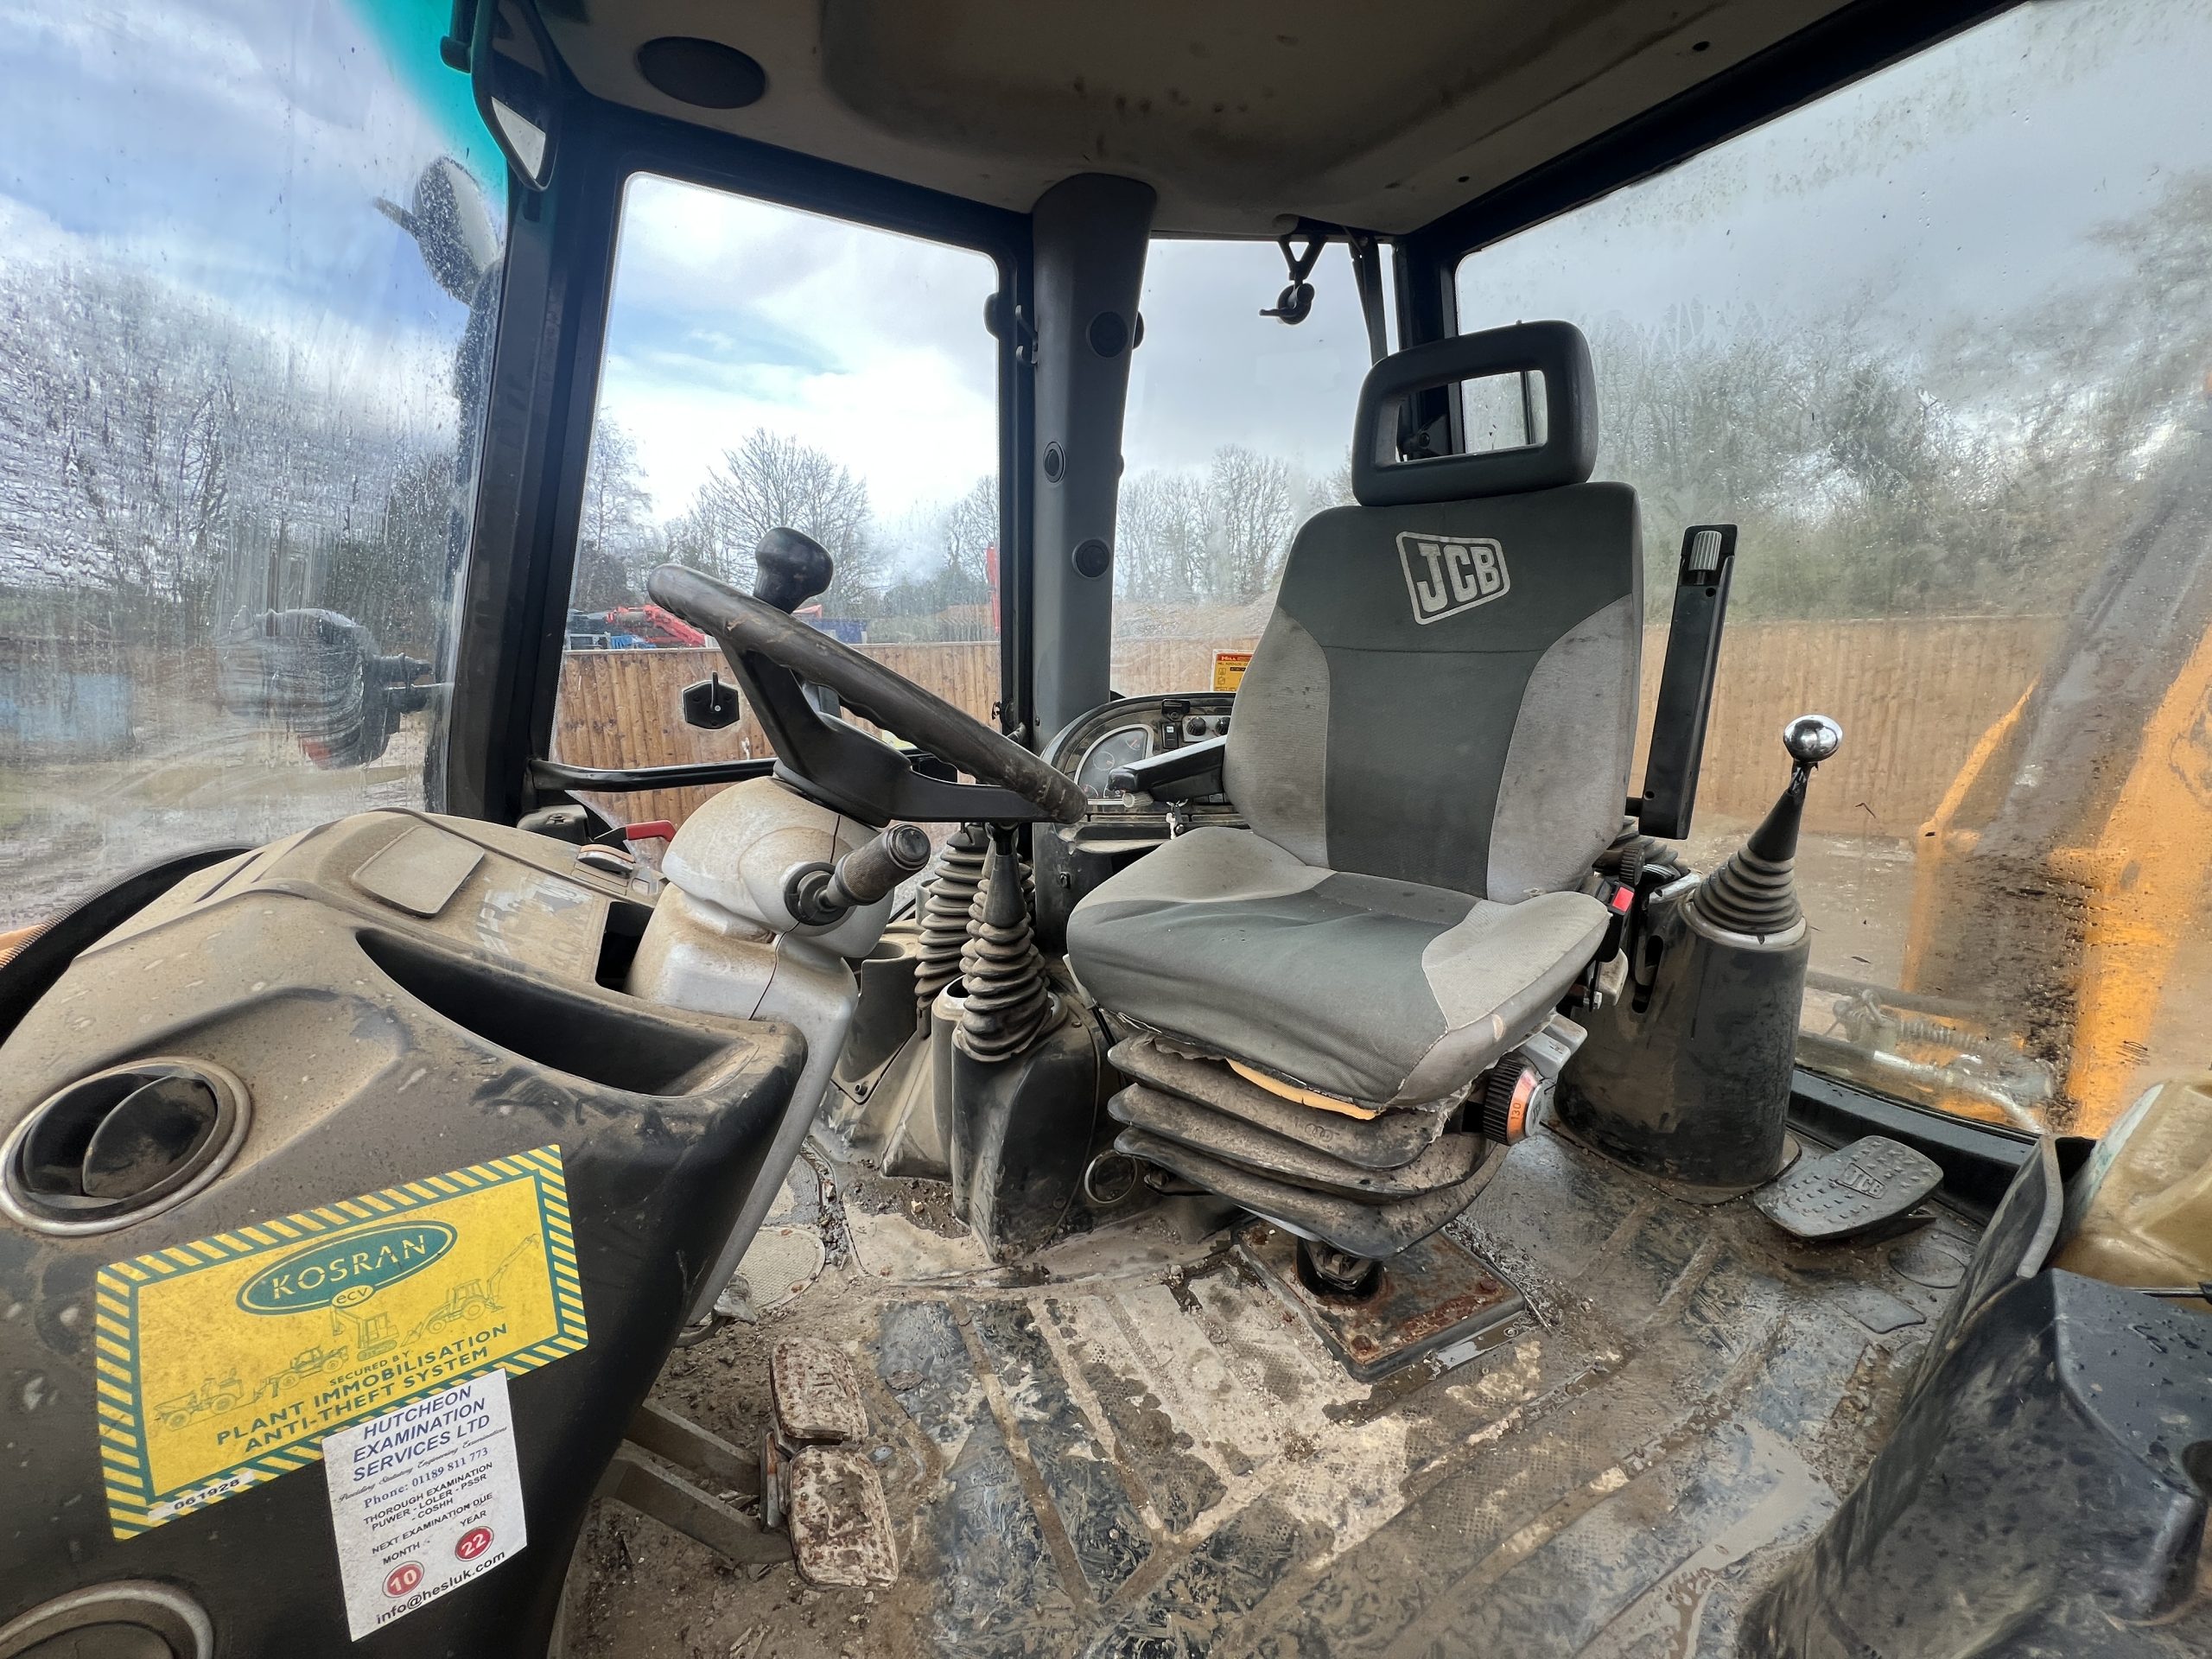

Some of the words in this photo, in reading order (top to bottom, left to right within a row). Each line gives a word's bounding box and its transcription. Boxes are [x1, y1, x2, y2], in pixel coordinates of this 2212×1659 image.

[1417, 543, 1500, 613] JCB
[1510, 1103, 1521, 1120] 130
[1842, 1166, 1885, 1195] JCB
[272, 1235, 426, 1300] KOSRAN
[336, 1287, 367, 1305] ecv
[217, 1402, 304, 1446] PLANT
[314, 1323, 507, 1408] IMMOBILISATION
[330, 1360, 387, 1386] SECURED
[392, 1351, 410, 1363] BY
[245, 1382, 395, 1452] ANTI-THEFT
[404, 1346, 487, 1389] SYSTEM
[364, 1385, 471, 1440] HUTCHEON
[353, 1397, 485, 1463] EXAMINATION
[353, 1431, 450, 1482] SERVICES
[457, 1414, 490, 1438] LTD
[174, 1479, 240, 1510] 061928
[364, 1484, 408, 1508] Phone:
[411, 1466, 444, 1486] 01189
[447, 1458, 467, 1471] 811
[469, 1446, 488, 1462] 773
[364, 1493, 423, 1524] THOROUGH
[426, 1462, 493, 1497] EXAMINATION
[372, 1509, 410, 1531] PUWER
[419, 1490, 453, 1509] LOLER
[461, 1473, 487, 1490] PSSR
[372, 1536, 400, 1554] NEXT
[402, 1503, 470, 1540] EXAMINATION
[473, 1492, 493, 1507] DUE
[417, 1497, 454, 1518] COSHH
[460, 1510, 486, 1527] YEAR
[383, 1541, 420, 1565] MONTH
[461, 1534, 486, 1556] 22
[376, 1551, 505, 1624] info@hesluk.com
[391, 1569, 417, 1592] 10
